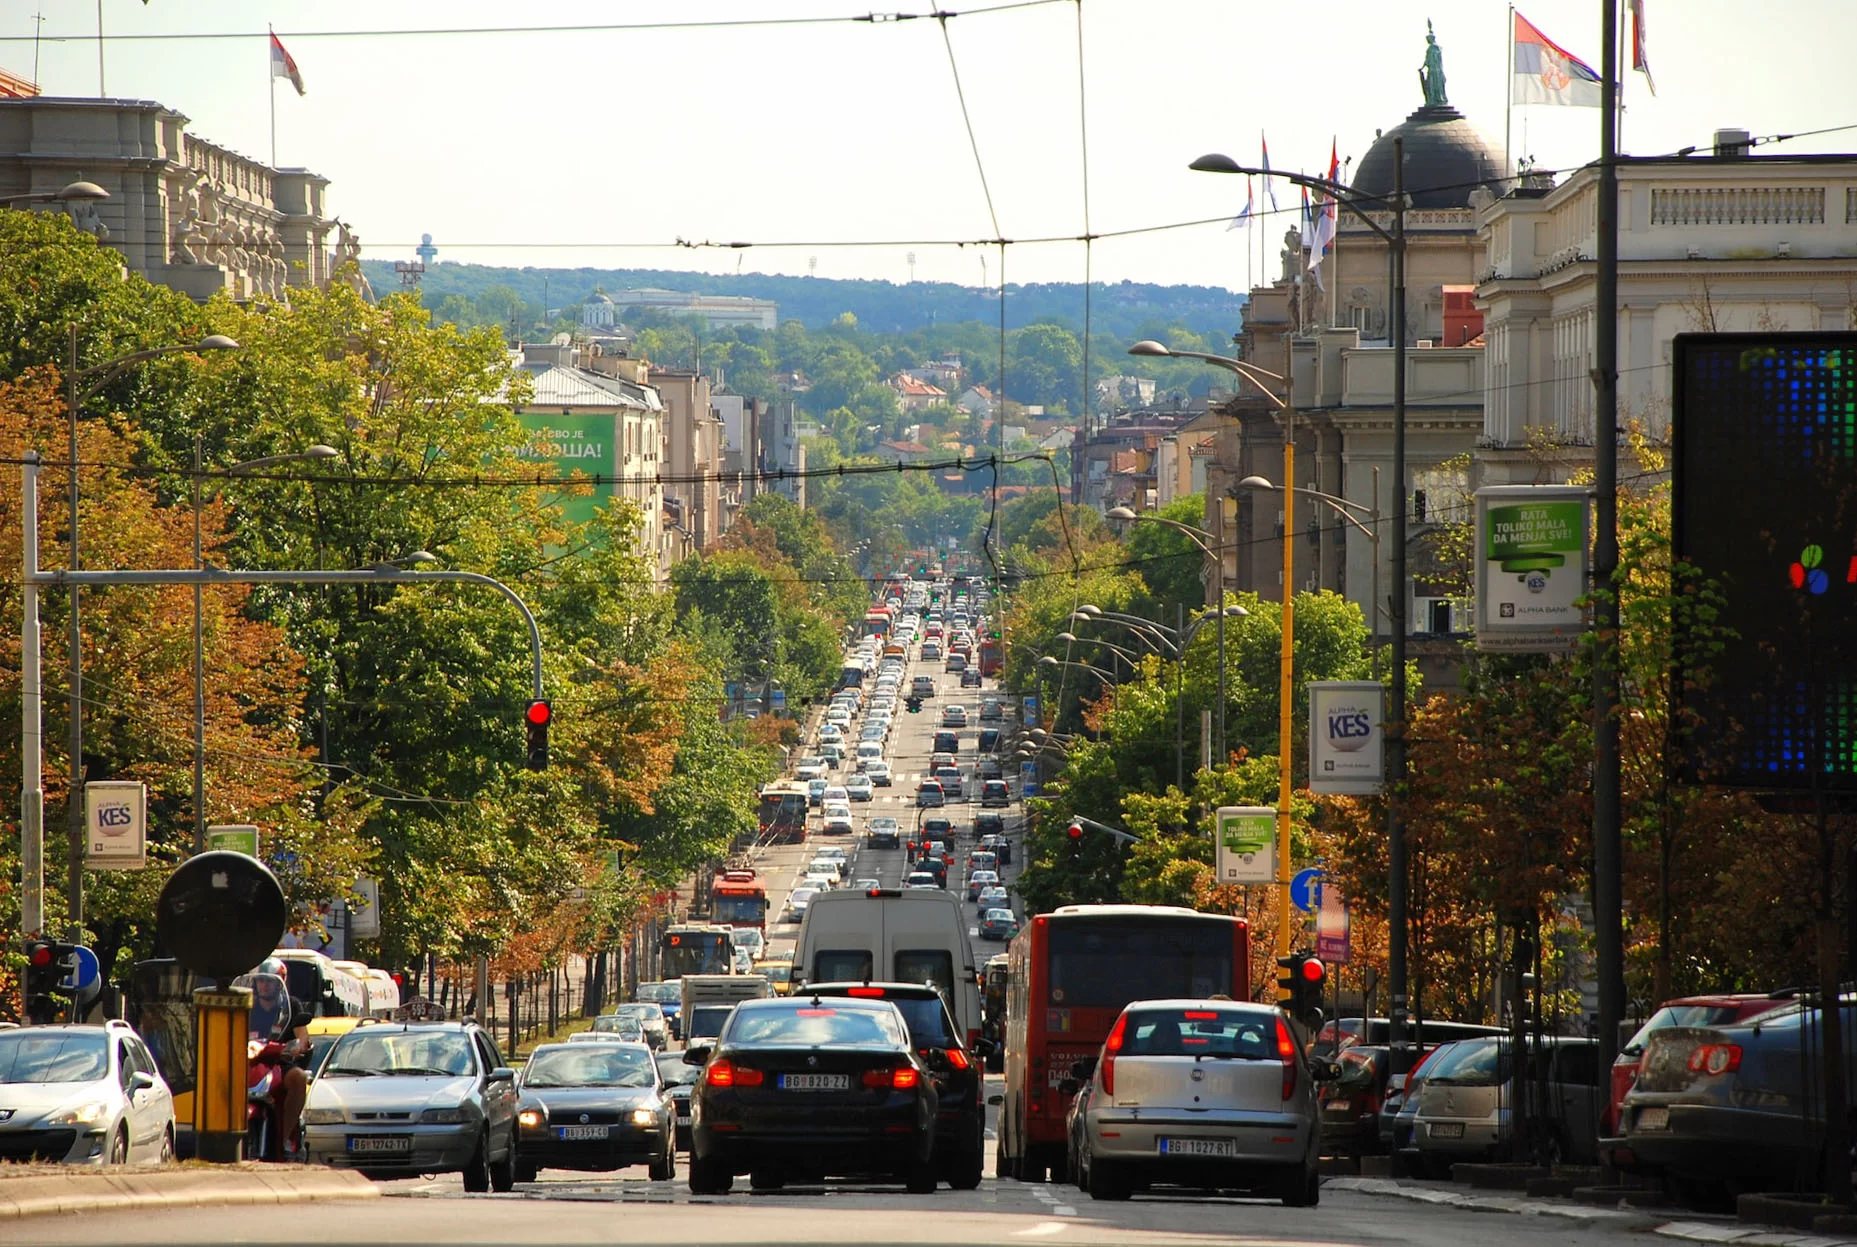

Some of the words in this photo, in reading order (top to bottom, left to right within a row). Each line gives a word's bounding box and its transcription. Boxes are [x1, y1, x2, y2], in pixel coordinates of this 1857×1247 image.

[1520, 511, 1547, 520] RATA
[1495, 521, 1533, 533] TOLIKO
[1537, 520, 1565, 529] MALA
[1493, 534, 1508, 544] DA
[1510, 532, 1546, 543] MENJA
[1548, 529, 1572, 540] SVE!
[412, 1004, 426, 1016] 595
[785, 1076, 800, 1088] BG
[808, 1076, 847, 1088] 820-ZZ
[1168, 1140, 1181, 1152] BG
